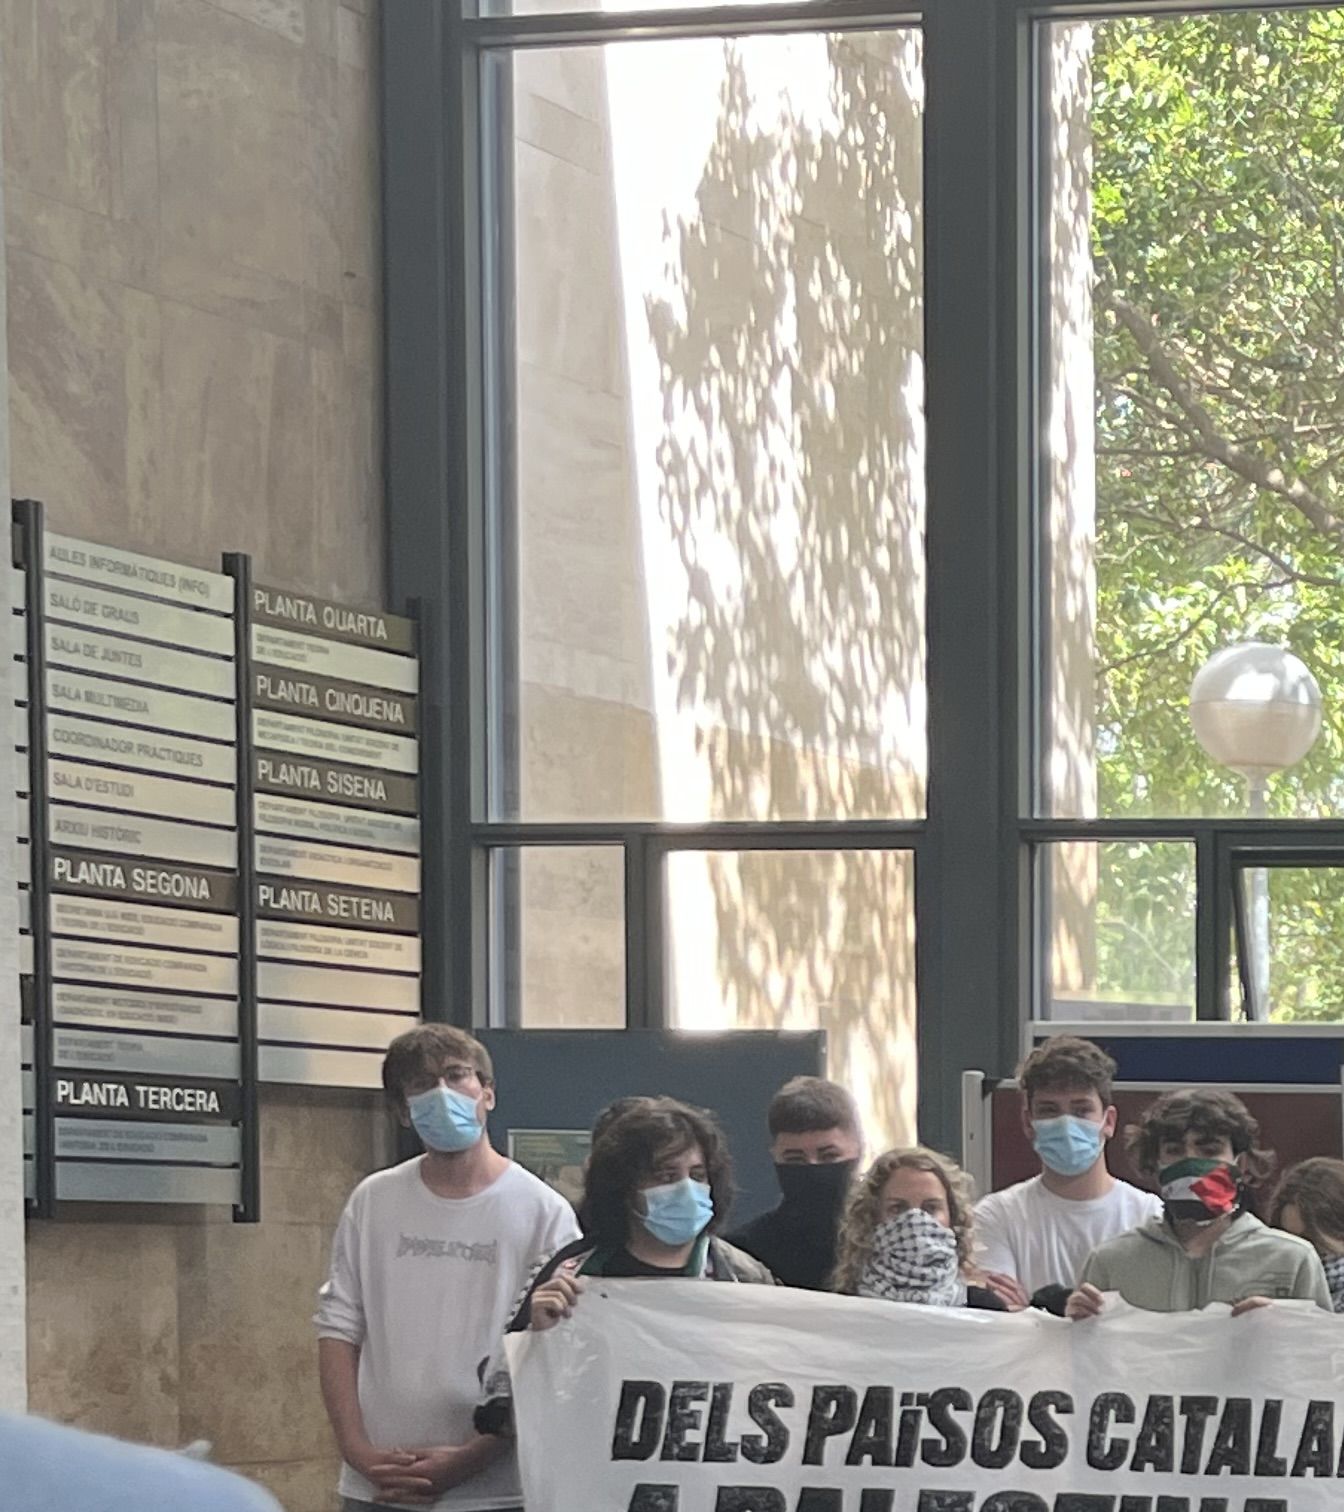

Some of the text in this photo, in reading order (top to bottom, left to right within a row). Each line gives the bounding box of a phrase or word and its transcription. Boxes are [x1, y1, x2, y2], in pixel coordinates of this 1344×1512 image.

[83, 601, 98, 616] DE
[254, 590, 388, 640] PLANTA QUARTA
[51, 637, 143, 668] SALA DE JUNTES
[52, 684, 82, 701] SALA
[255, 675, 405, 723] PLANTA CINQUENA
[53, 728, 134, 754] COORDINADOR
[53, 772, 135, 797] SALA D'ESTUDI
[257, 759, 388, 801] PLANTA SISENA
[54, 857, 211, 900] PLANTA SEGONA
[258, 884, 395, 922] PLANTA SETENA
[57, 1080, 220, 1113] PLANTA TERCERA
[610, 1379, 795, 1465] DELS
